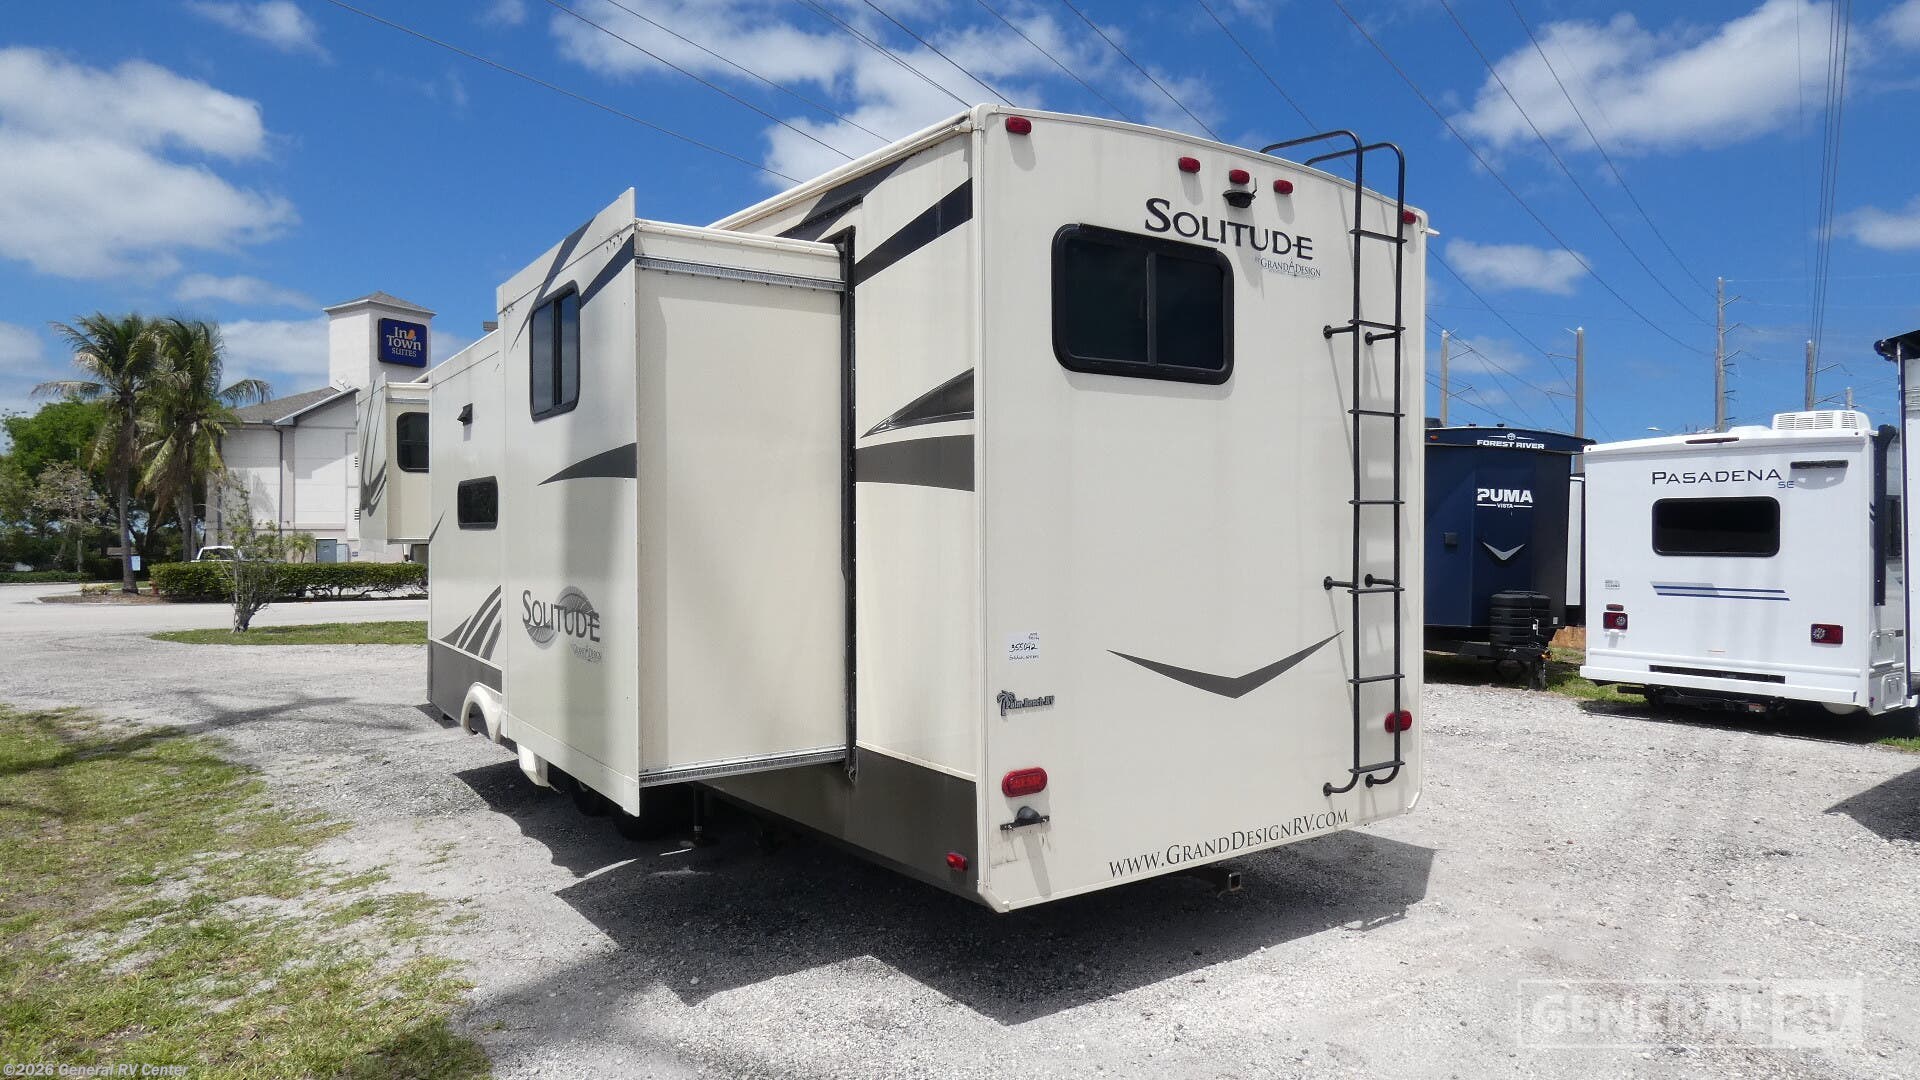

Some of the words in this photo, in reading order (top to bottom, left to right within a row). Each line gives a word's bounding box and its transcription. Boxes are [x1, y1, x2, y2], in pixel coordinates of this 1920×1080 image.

[1145, 197, 1313, 260] SOLITUDE
[394, 326, 407, 339] In
[1476, 439, 1515, 448] FOREST
[1516, 441, 1545, 450] RIVER
[1651, 468, 1782, 485] PASADENA
[1777, 480, 1795, 489] SE
[1476, 488, 1534, 503] PUMA
[522, 589, 601, 642] SOLITUDE
